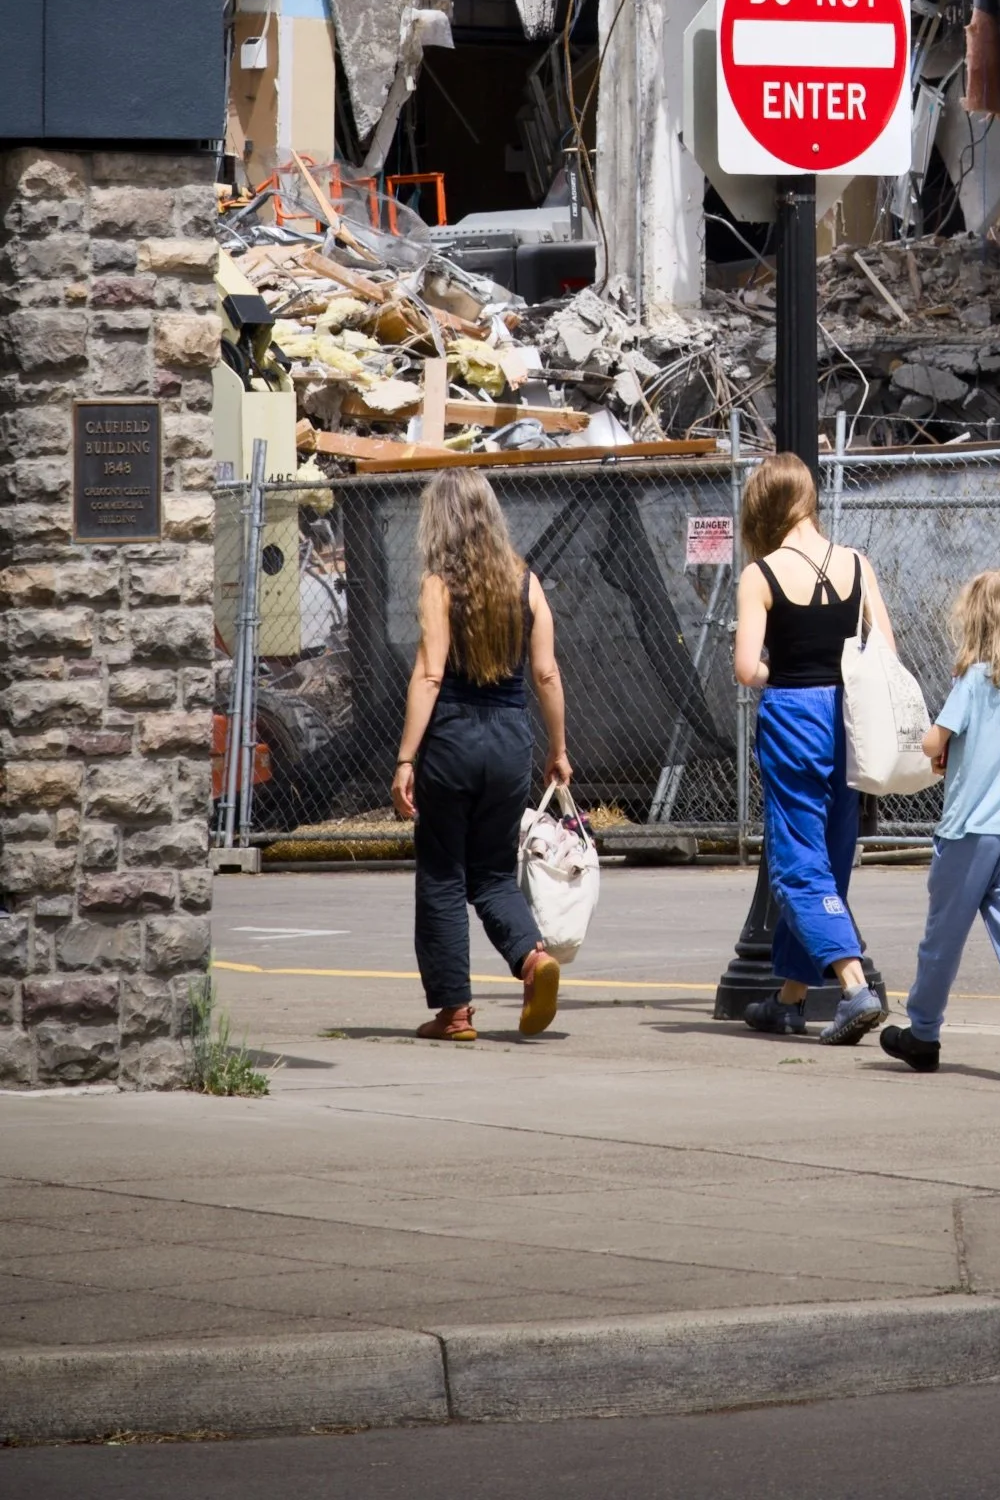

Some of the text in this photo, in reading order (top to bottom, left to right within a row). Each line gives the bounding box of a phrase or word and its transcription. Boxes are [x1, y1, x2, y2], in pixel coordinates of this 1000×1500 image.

[762, 81, 867, 121] ENTER
[85, 419, 151, 435] CAUFIELD
[84, 440, 151, 455] BUILDING
[104, 460, 132, 474] 1848
